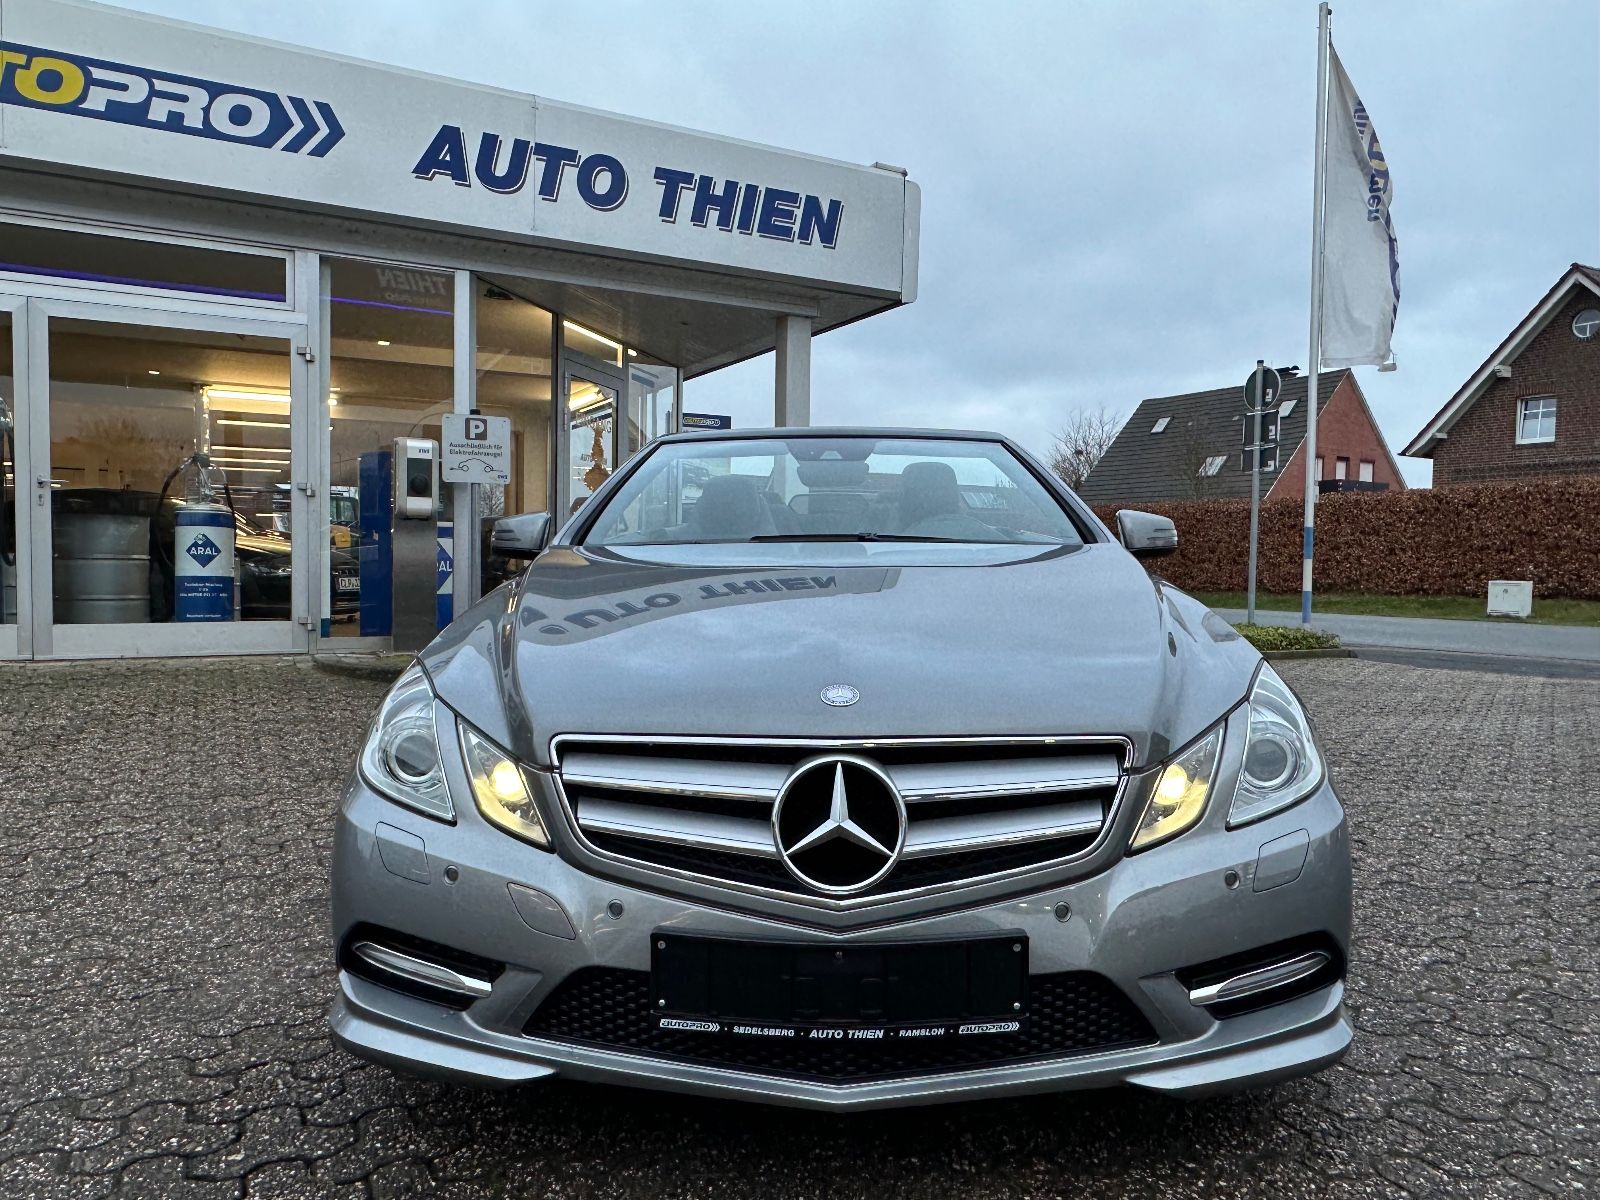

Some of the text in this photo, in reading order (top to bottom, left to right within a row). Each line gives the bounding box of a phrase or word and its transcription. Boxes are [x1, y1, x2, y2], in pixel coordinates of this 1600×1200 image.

[411, 124, 844, 249] AUTO THIEN
[469, 419, 485, 439] P
[190, 547, 218, 555] ARAL
[437, 560, 453, 572] AL
[733, 1025, 795, 1037] SEDELSBERG
[809, 1029, 844, 1039] AUTO
[848, 1029, 884, 1039] THIEN
[899, 1027, 945, 1037] RAMSLOH
